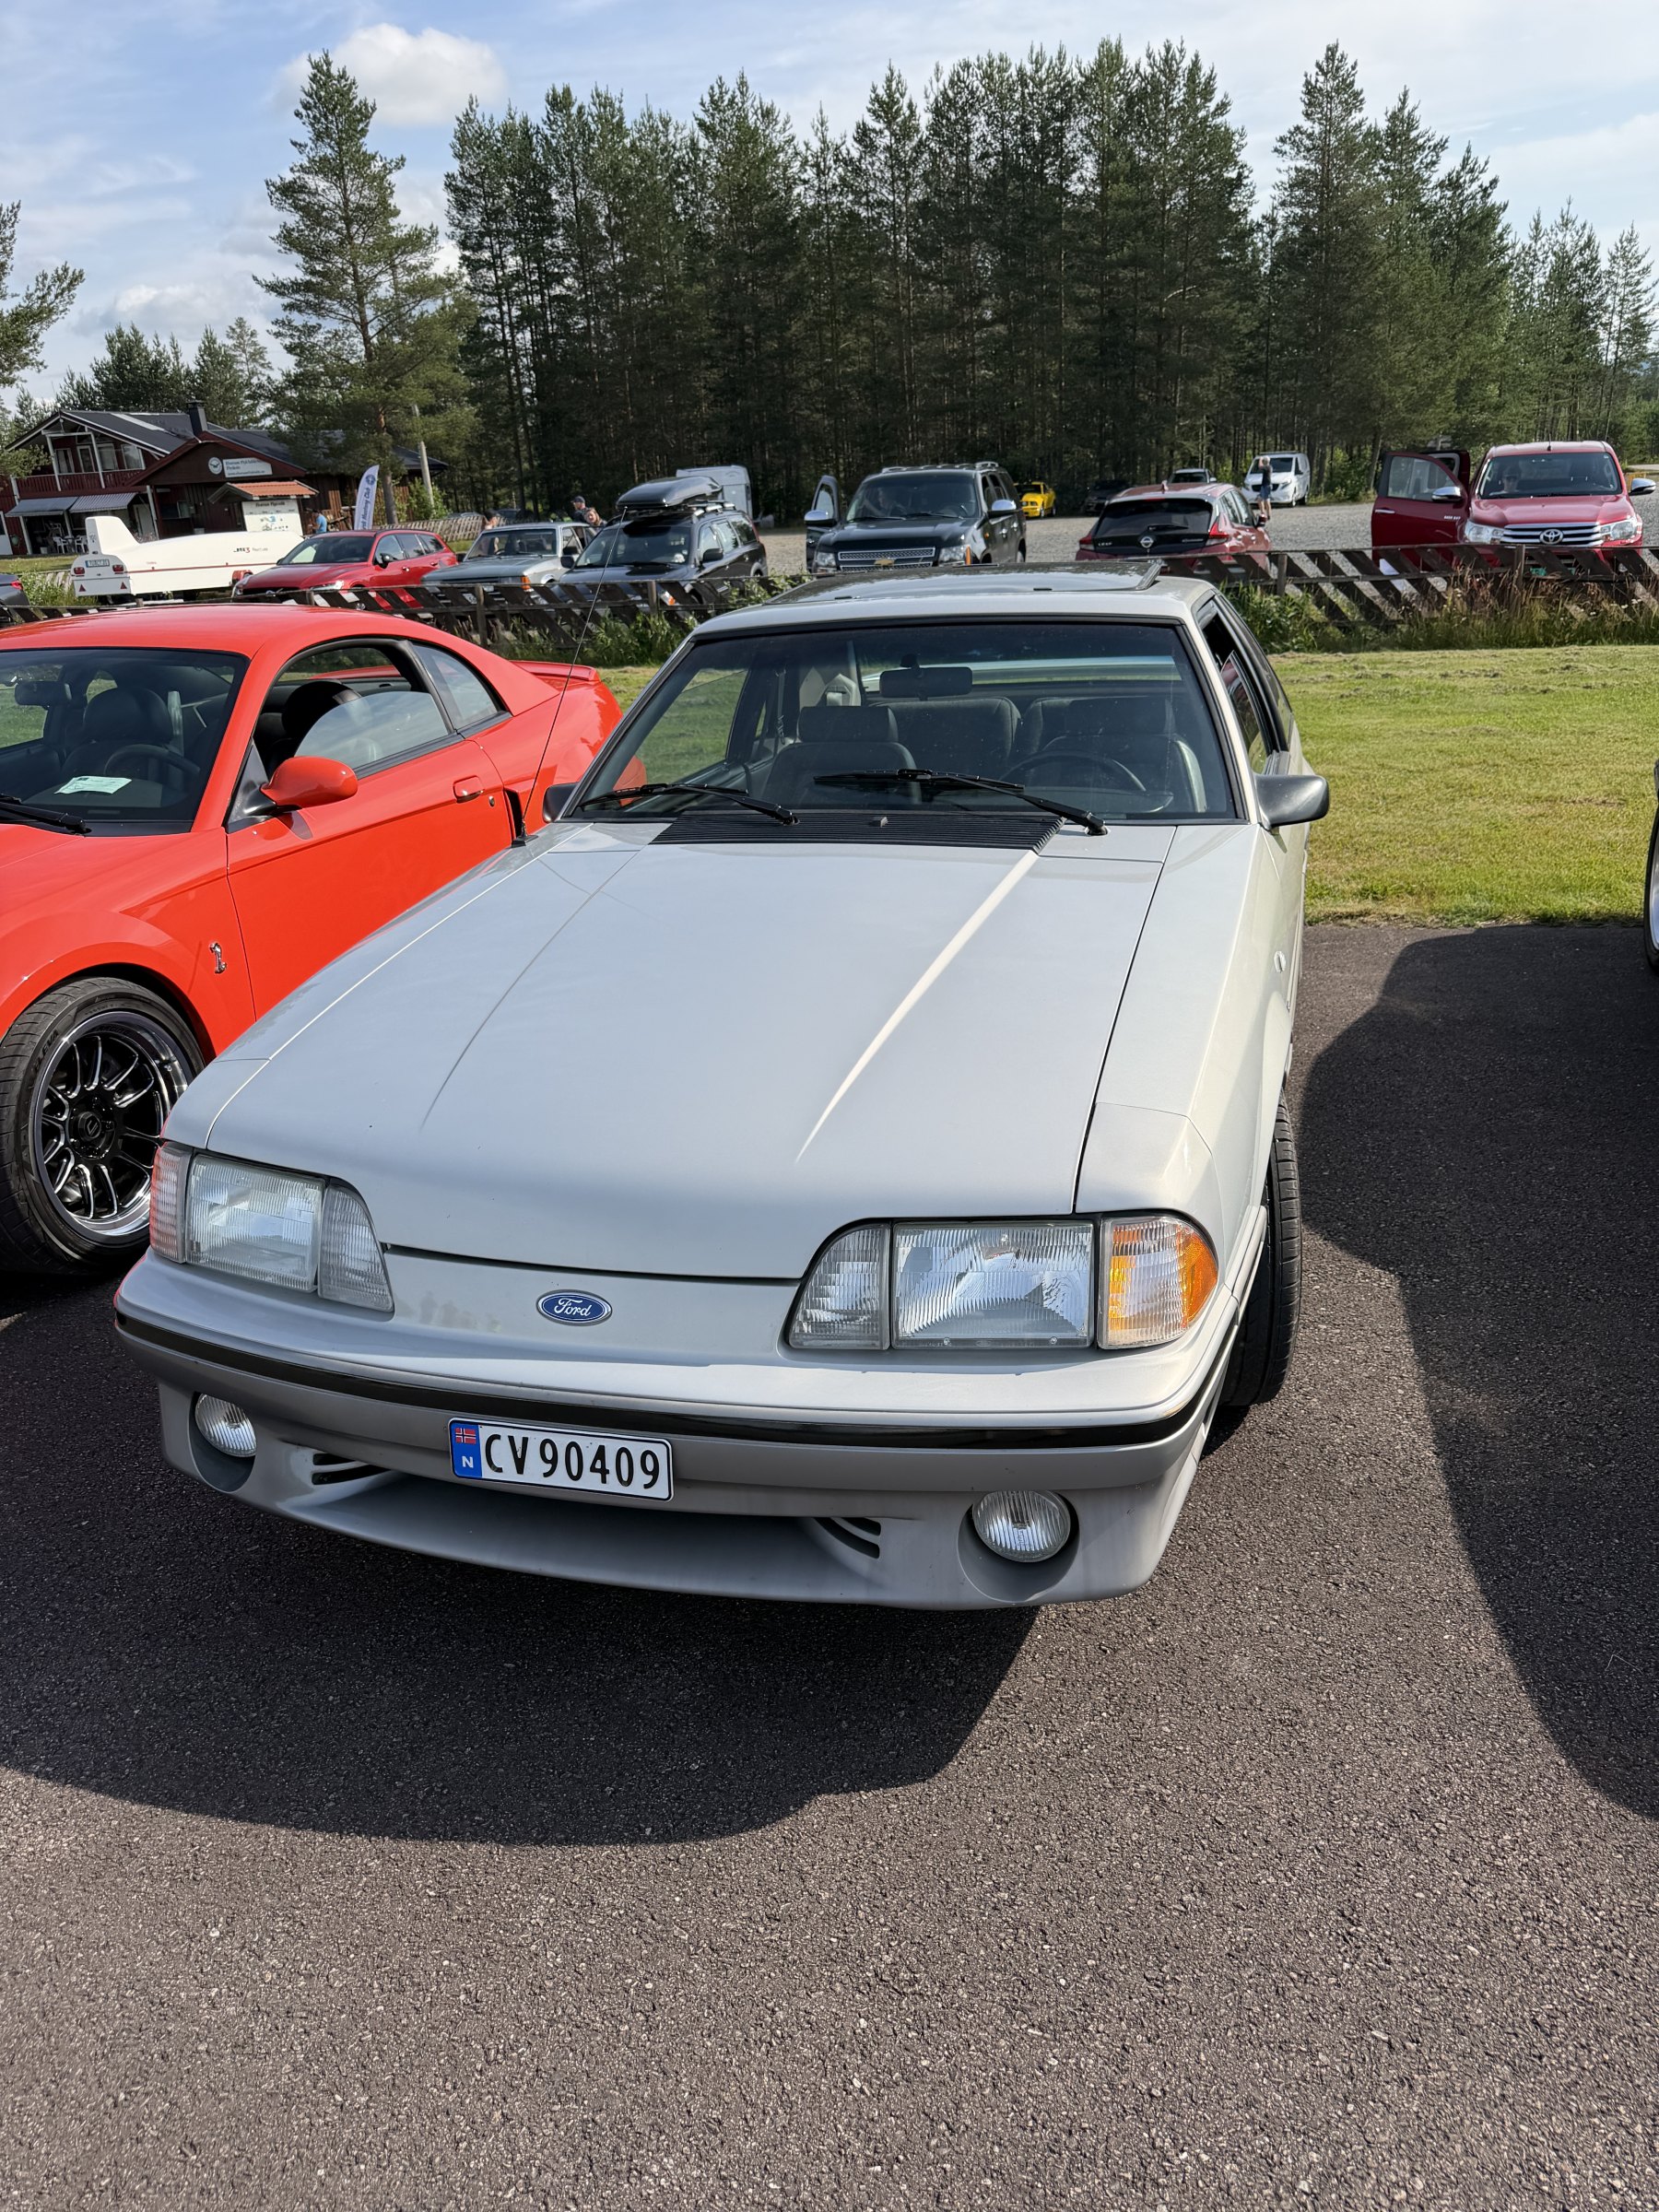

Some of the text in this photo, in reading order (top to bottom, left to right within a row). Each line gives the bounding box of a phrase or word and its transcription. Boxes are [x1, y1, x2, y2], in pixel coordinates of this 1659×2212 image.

[554, 1298, 592, 1317] Ford
[462, 1434, 660, 1489] N CV90409
